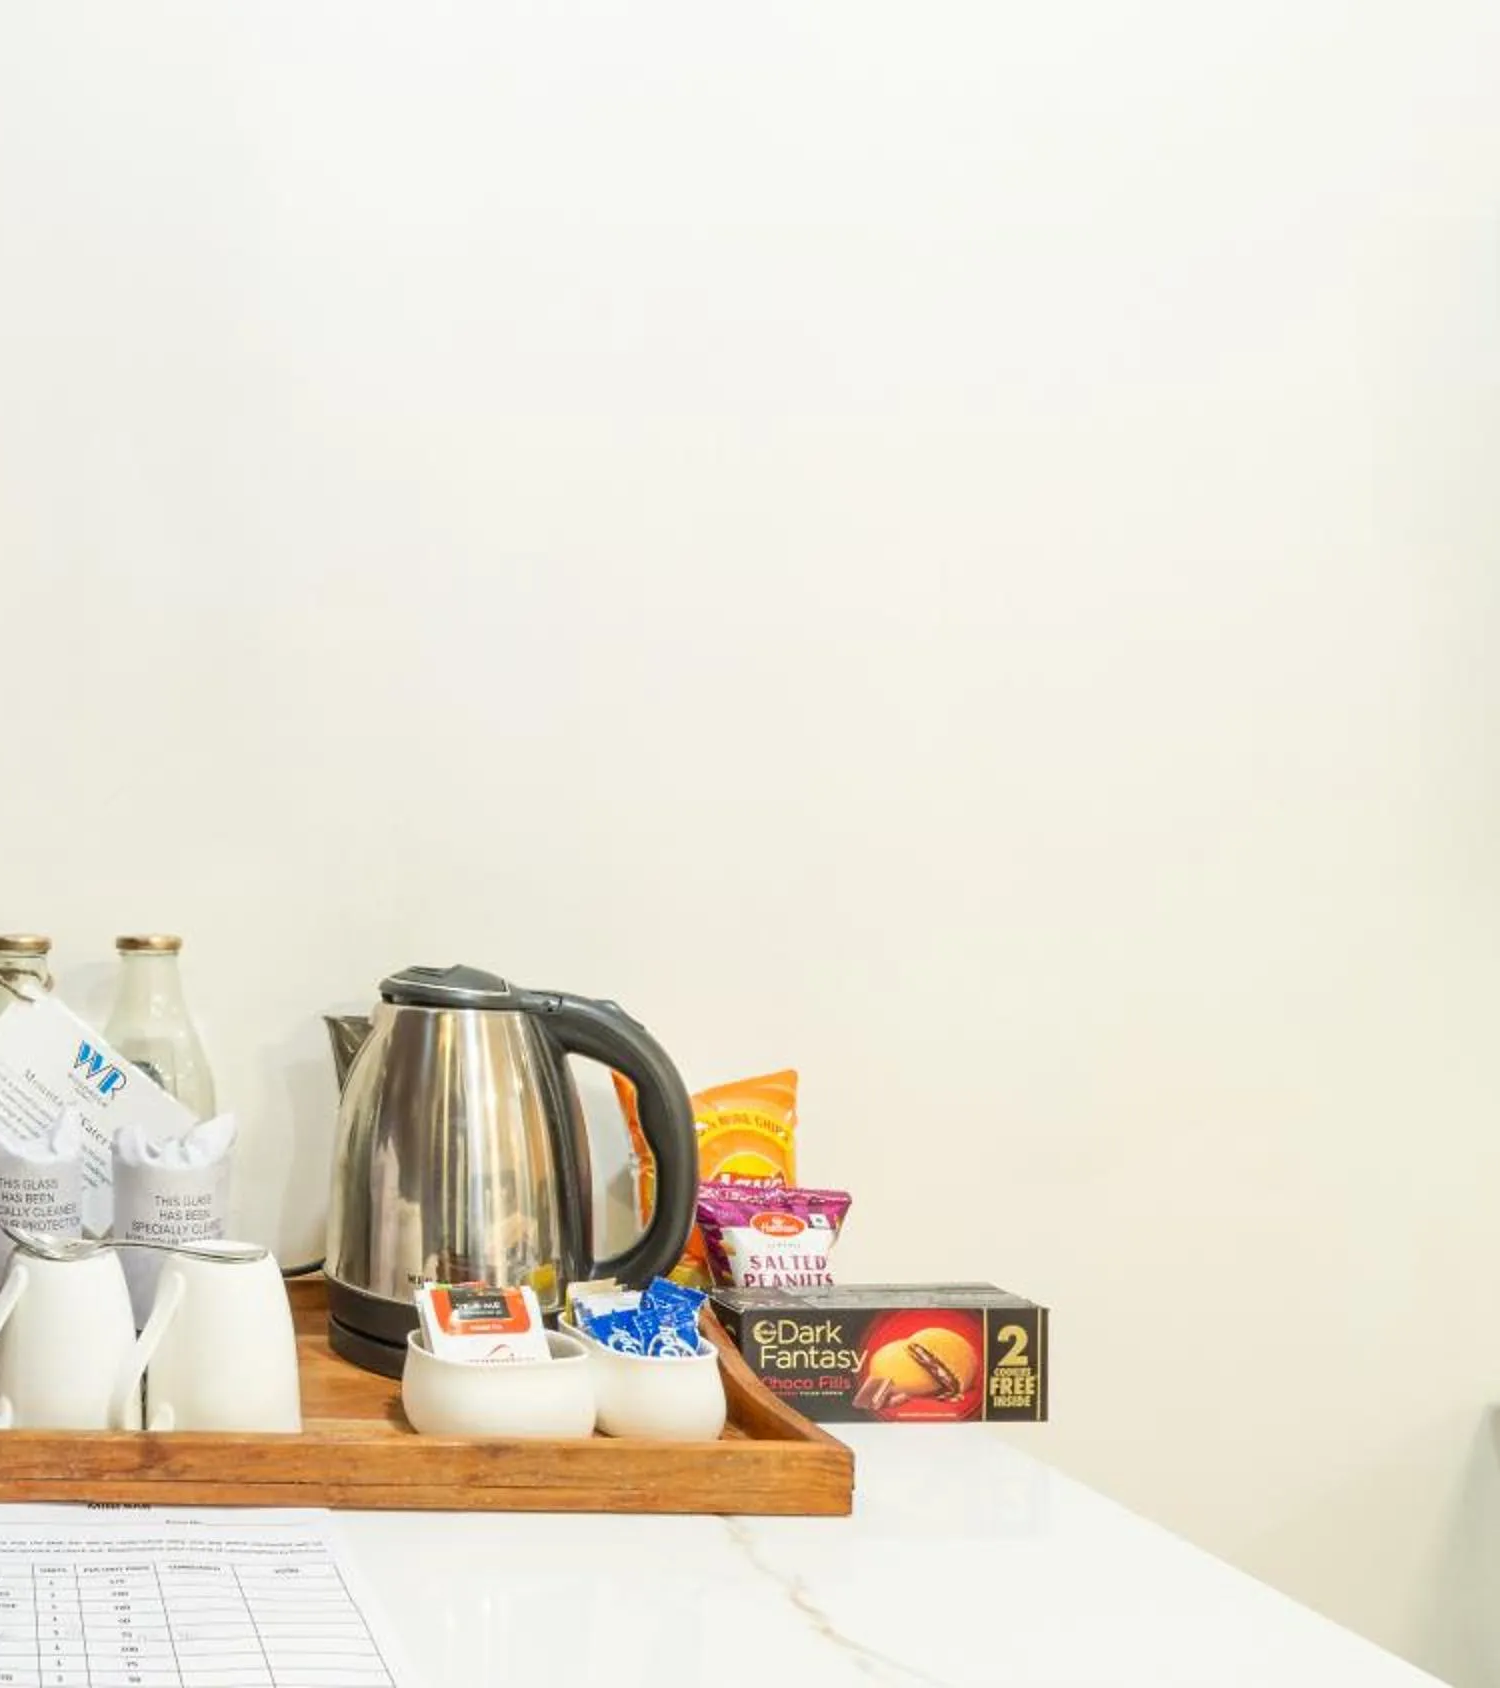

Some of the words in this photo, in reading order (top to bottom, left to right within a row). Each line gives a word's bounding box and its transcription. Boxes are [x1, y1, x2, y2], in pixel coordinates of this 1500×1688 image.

[22, 1179, 59, 1190] GLASS
[1, 1192, 22, 1203] HAS
[25, 1193, 55, 1203] BEEN
[155, 1194, 181, 1207] THIS
[159, 1209, 182, 1220] HAS
[749, 1254, 827, 1271] SALTED
[743, 1271, 835, 1288] PEANUTS
[778, 1319, 843, 1345] Dark
[997, 1324, 1029, 1367] 2
[760, 1344, 869, 1374] Fantasy
[761, 1375, 815, 1390] Choco
[819, 1375, 852, 1390] Fills
[989, 1376, 1036, 1396] FREE
[993, 1395, 1032, 1408] INSIDE
